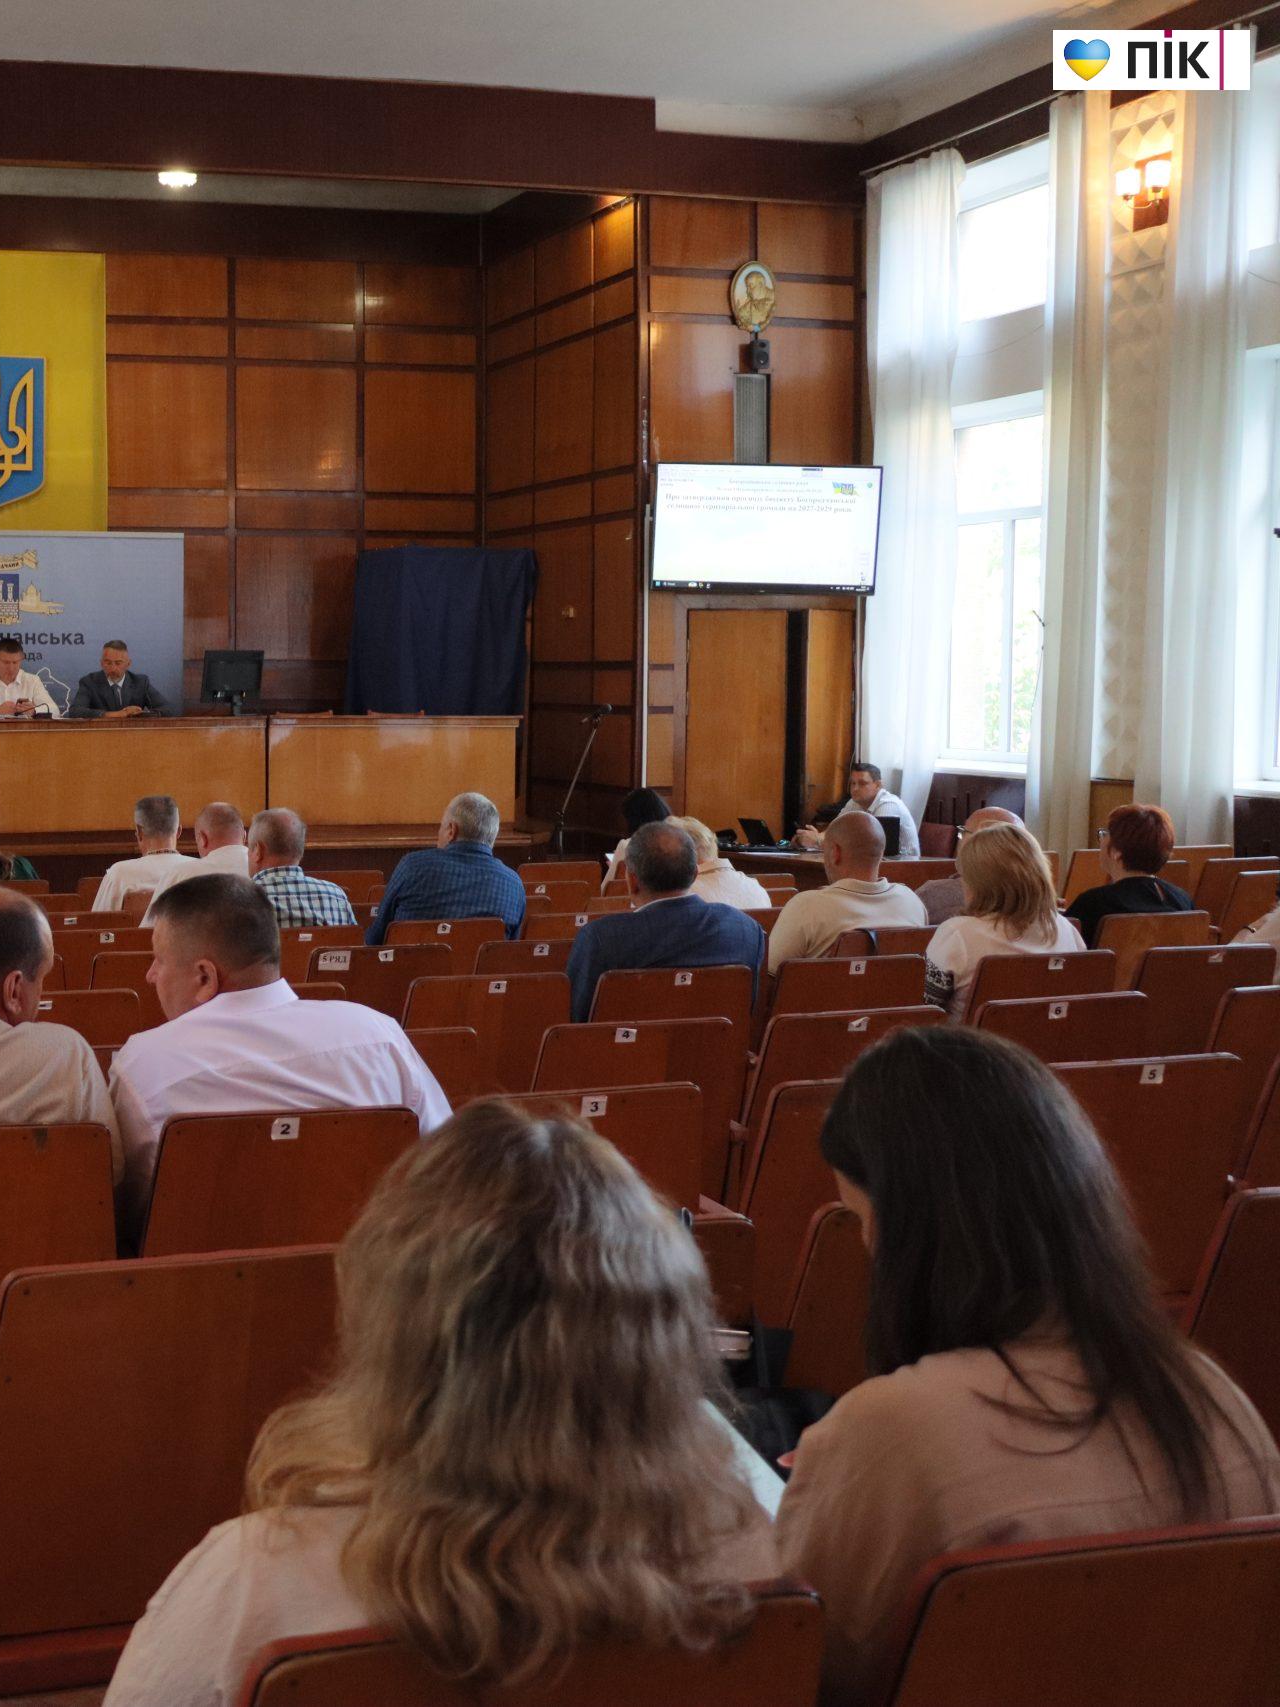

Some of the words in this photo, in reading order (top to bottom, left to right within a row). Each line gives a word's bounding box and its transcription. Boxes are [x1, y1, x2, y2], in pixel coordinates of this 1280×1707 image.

[1054, 1006, 1062, 1015] 6
[622, 1030, 630, 1039] 4
[1147, 1069, 1156, 1080] 5
[589, 1101, 599, 1113] 3
[280, 1123, 291, 1135] 2
